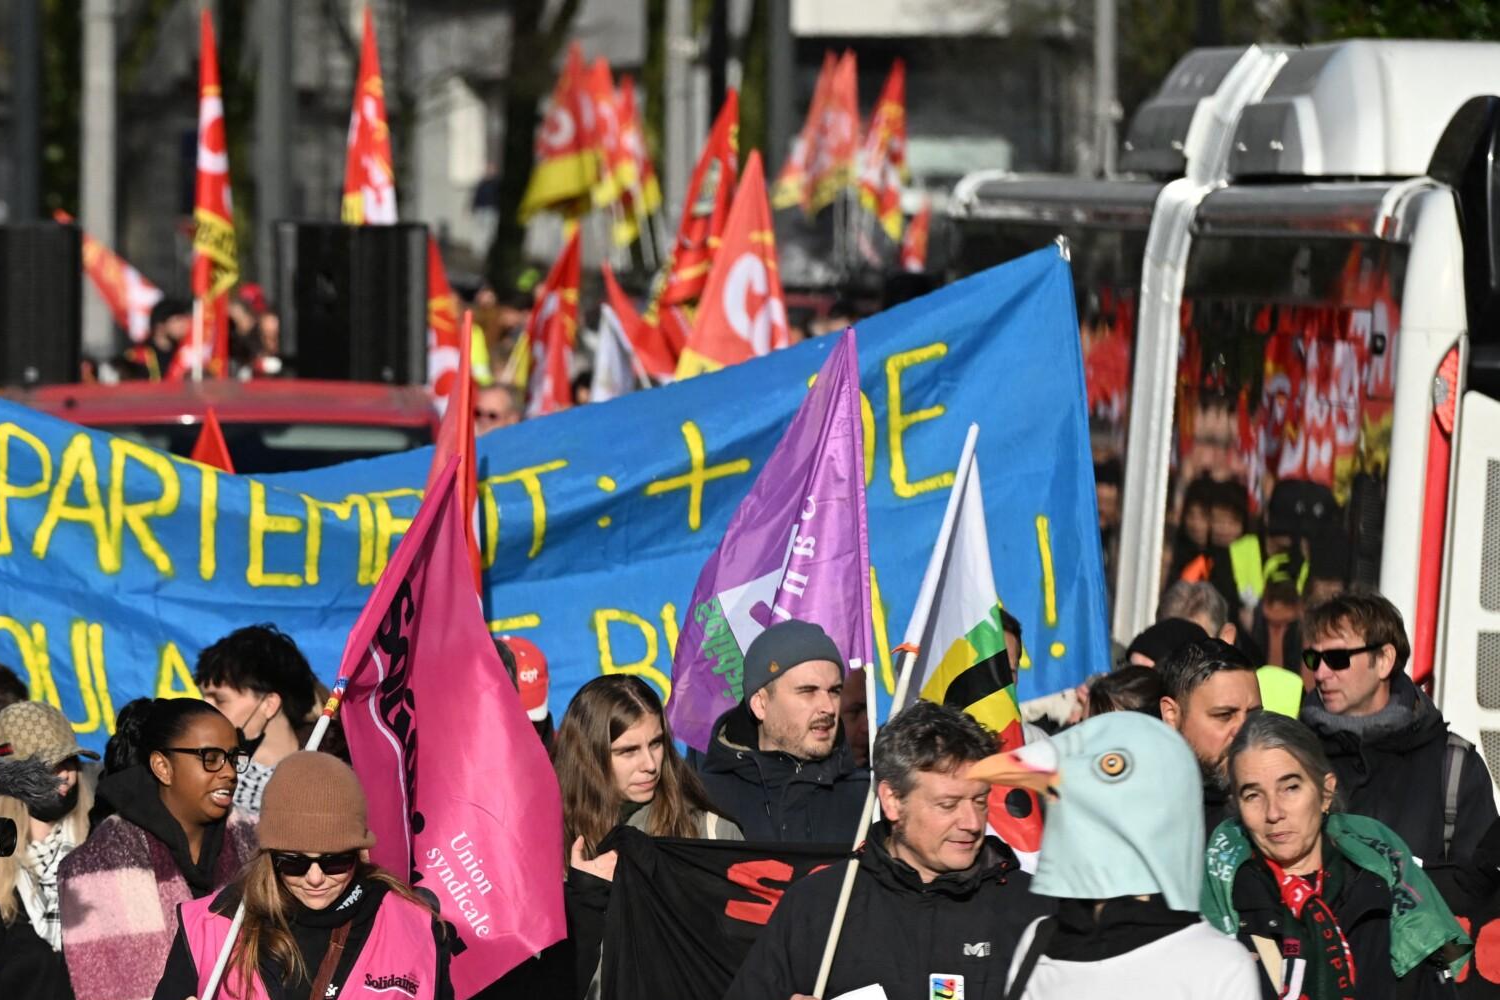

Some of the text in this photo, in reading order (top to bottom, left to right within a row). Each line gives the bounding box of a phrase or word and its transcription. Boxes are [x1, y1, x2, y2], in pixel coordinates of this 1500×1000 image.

[426, 845, 492, 939] syndicale
[448, 830, 495, 897] Union
[364, 973, 419, 996] Solidaires
